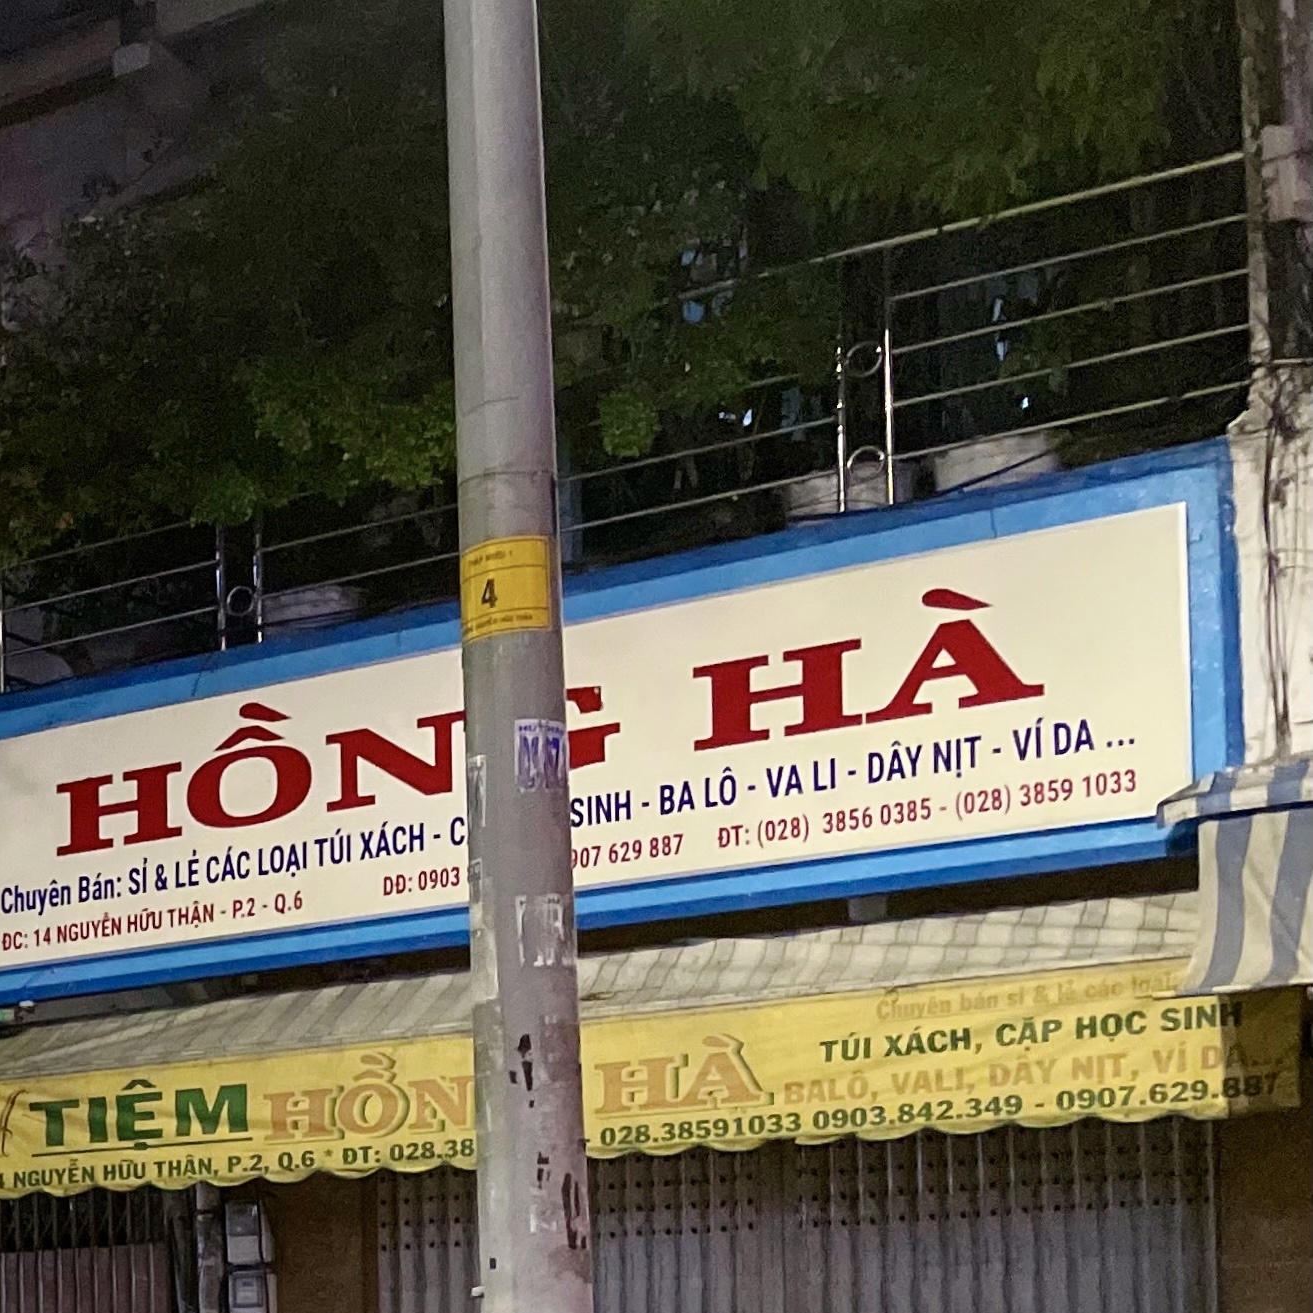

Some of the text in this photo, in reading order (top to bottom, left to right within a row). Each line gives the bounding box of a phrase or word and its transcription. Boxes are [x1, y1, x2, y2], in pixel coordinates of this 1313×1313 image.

[481, 578, 498, 608] 4
[693, 588, 1045, 751] HÀ
[570, 790, 632, 828] SINH
[659, 780, 695, 816] BA
[705, 766, 737, 808] LÔ
[766, 764, 803, 798] VA
[813, 757, 836, 793] LI
[868, 740, 923, 785] DÂY
[933, 735, 982, 779] NỊT
[1012, 716, 1044, 762] VÍ
[1053, 719, 1095, 757] DA
[718, 824, 750, 848] ĐT:
[757, 813, 810, 849] (028)
[823, 806, 873, 834] 3856
[880, 797, 932, 826] 0385
[955, 784, 1011, 822] (028)
[1020, 778, 1073, 807] 3859
[1082, 768, 1137, 798] 1033
[1, 879, 71, 916] Chuyên
[78, 873, 122, 903] Bán:
[128, 857, 147, 895] SỈ
[155, 864, 168, 891] &
[175, 849, 200, 888] LẺ
[206, 846, 250, 884] CÁC
[258, 841, 308, 878] LOẠI
[314, 828, 351, 867] TÚI
[360, 821, 425, 861] XÁCH
[608, 838, 642, 865] 629
[649, 833, 684, 859] 887
[383, 866, 461, 896] DĐ: 0903
[2, 932, 29, 951] ĐC:
[34, 926, 52, 947] 14
[57, 911, 122, 944] NGUYỄN
[127, 907, 163, 933] HỮU
[168, 900, 215, 929] THẬN
[232, 897, 256, 919] P.2
[274, 890, 303, 915] Q.6
[819, 1001, 1244, 1063] TÚI XÁCH, CẶP HỌC SINH
[262, 1050, 475, 1143] HỒN
[594, 1032, 775, 1119] HÀ
[783, 1068, 879, 1104] BALÔ,
[890, 1066, 976, 1096] VALI,
[988, 1055, 1059, 1088] DÂY
[1071, 1051, 1140, 1084] NỊT,
[1151, 1040, 1188, 1075] VÍ
[599, 1112, 802, 1147] 028.38591033
[812, 1094, 1023, 1130] 0903.842.349
[1056, 1072, 1280, 1111] 0907.629.887
[13, 1158, 95, 1188] NGUYỄN
[227, 1154, 270, 1176] P.2,
[277, 1150, 315, 1171] Q.6
[341, 1137, 475, 1165] ĐT: 028.38
